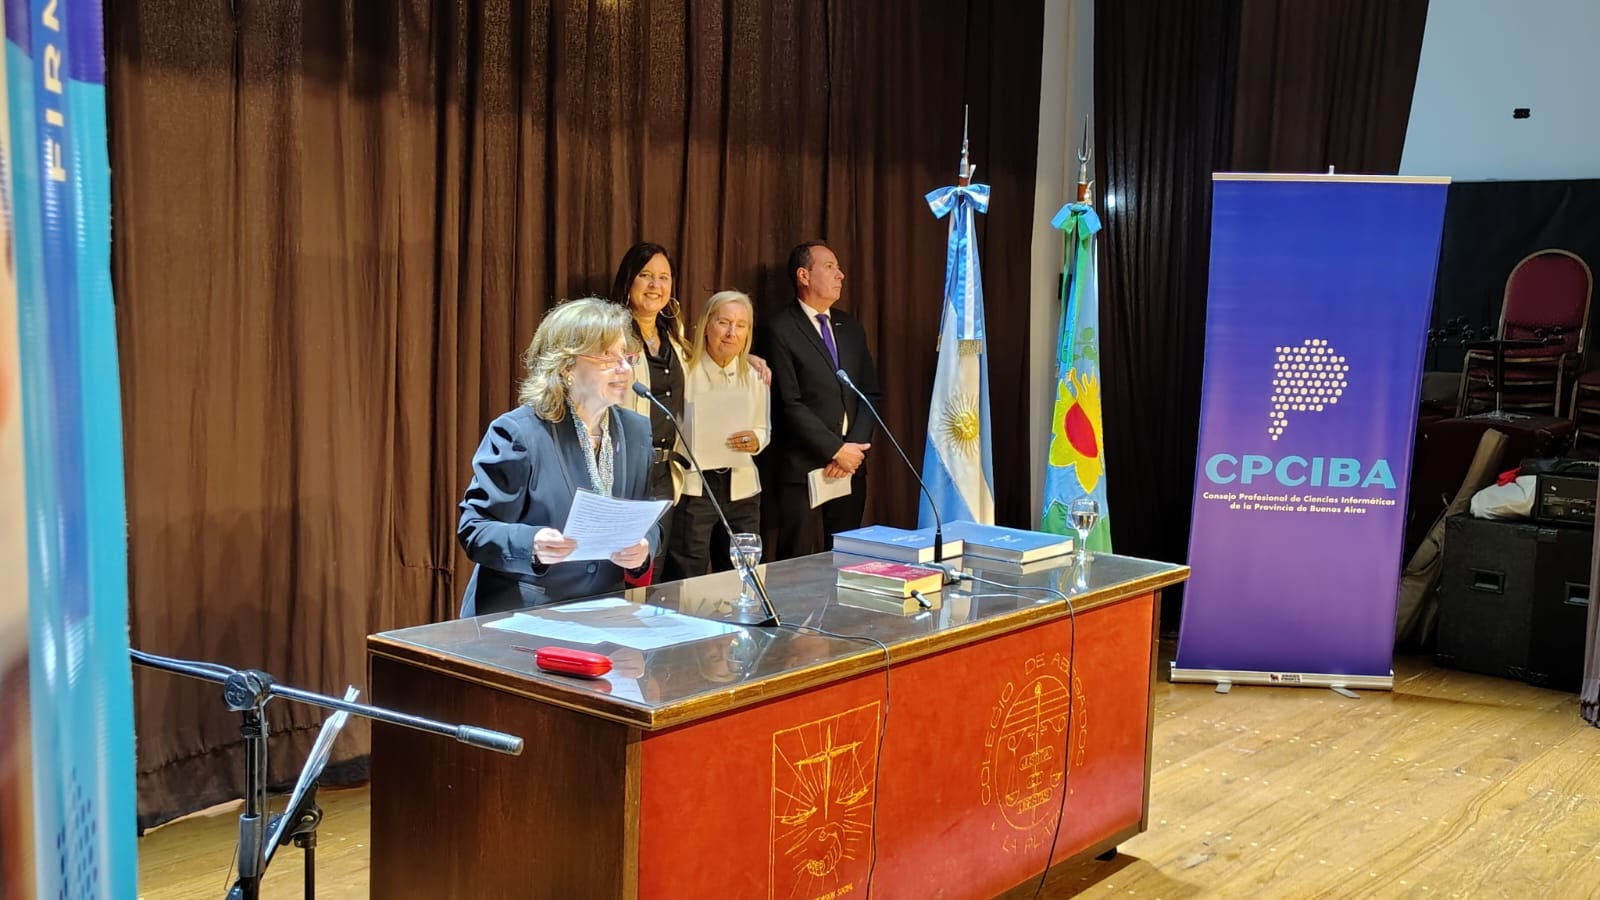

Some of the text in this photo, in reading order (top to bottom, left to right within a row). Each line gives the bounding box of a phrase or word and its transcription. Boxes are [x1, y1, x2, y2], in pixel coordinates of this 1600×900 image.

[1205, 453, 1396, 489] CPCIBA
[1202, 491, 1396, 506] Consejo Profesional de Ciencias Informáticas
[1229, 501, 1367, 514] de la Provincia de Buenos Aires
[981, 681, 1014, 806] COLEGIO
[1024, 652, 1046, 676] DE
